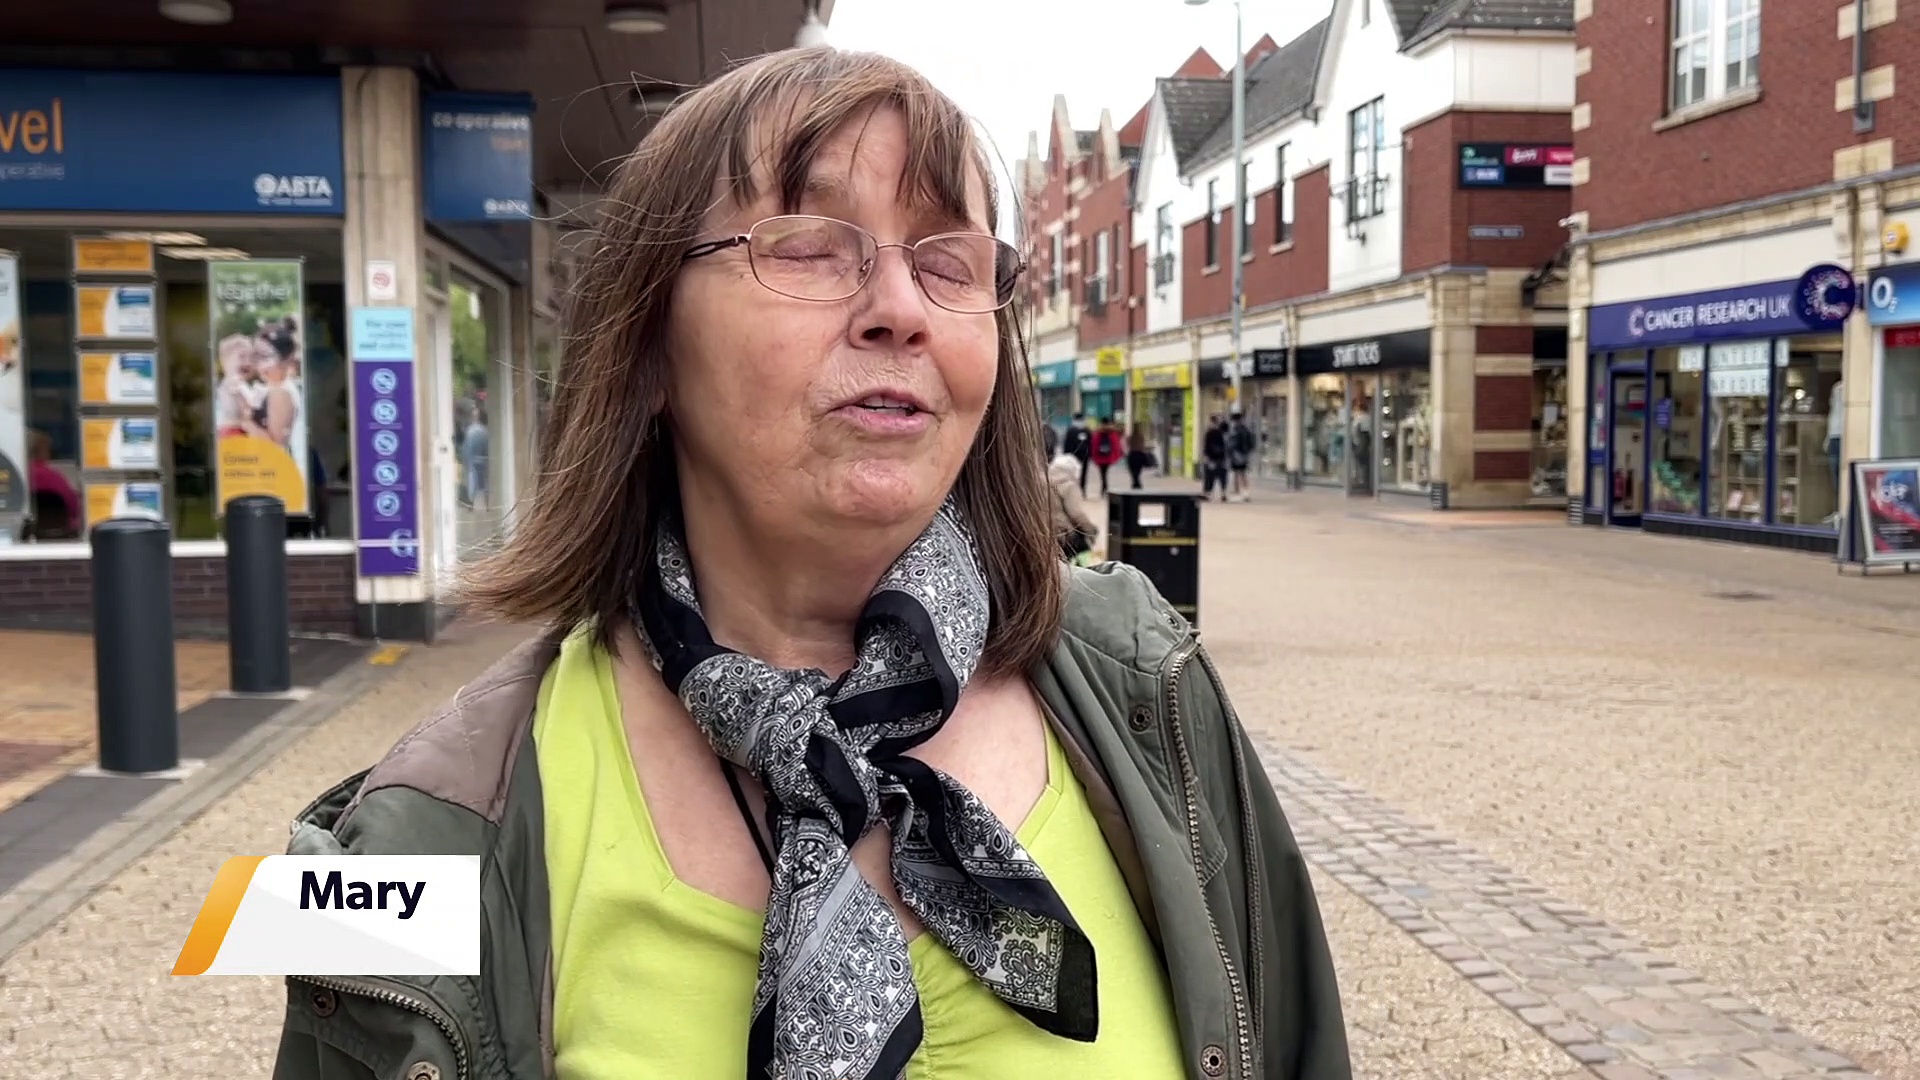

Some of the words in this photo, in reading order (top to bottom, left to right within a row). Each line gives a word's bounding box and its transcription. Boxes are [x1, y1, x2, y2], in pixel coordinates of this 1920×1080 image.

[0, 97, 64, 153] vel
[277, 175, 333, 198] ABTA
[1644, 305, 1694, 331] CANCER
[1697, 297, 1767, 326] RESEARCH
[1768, 294, 1792, 318] UK
